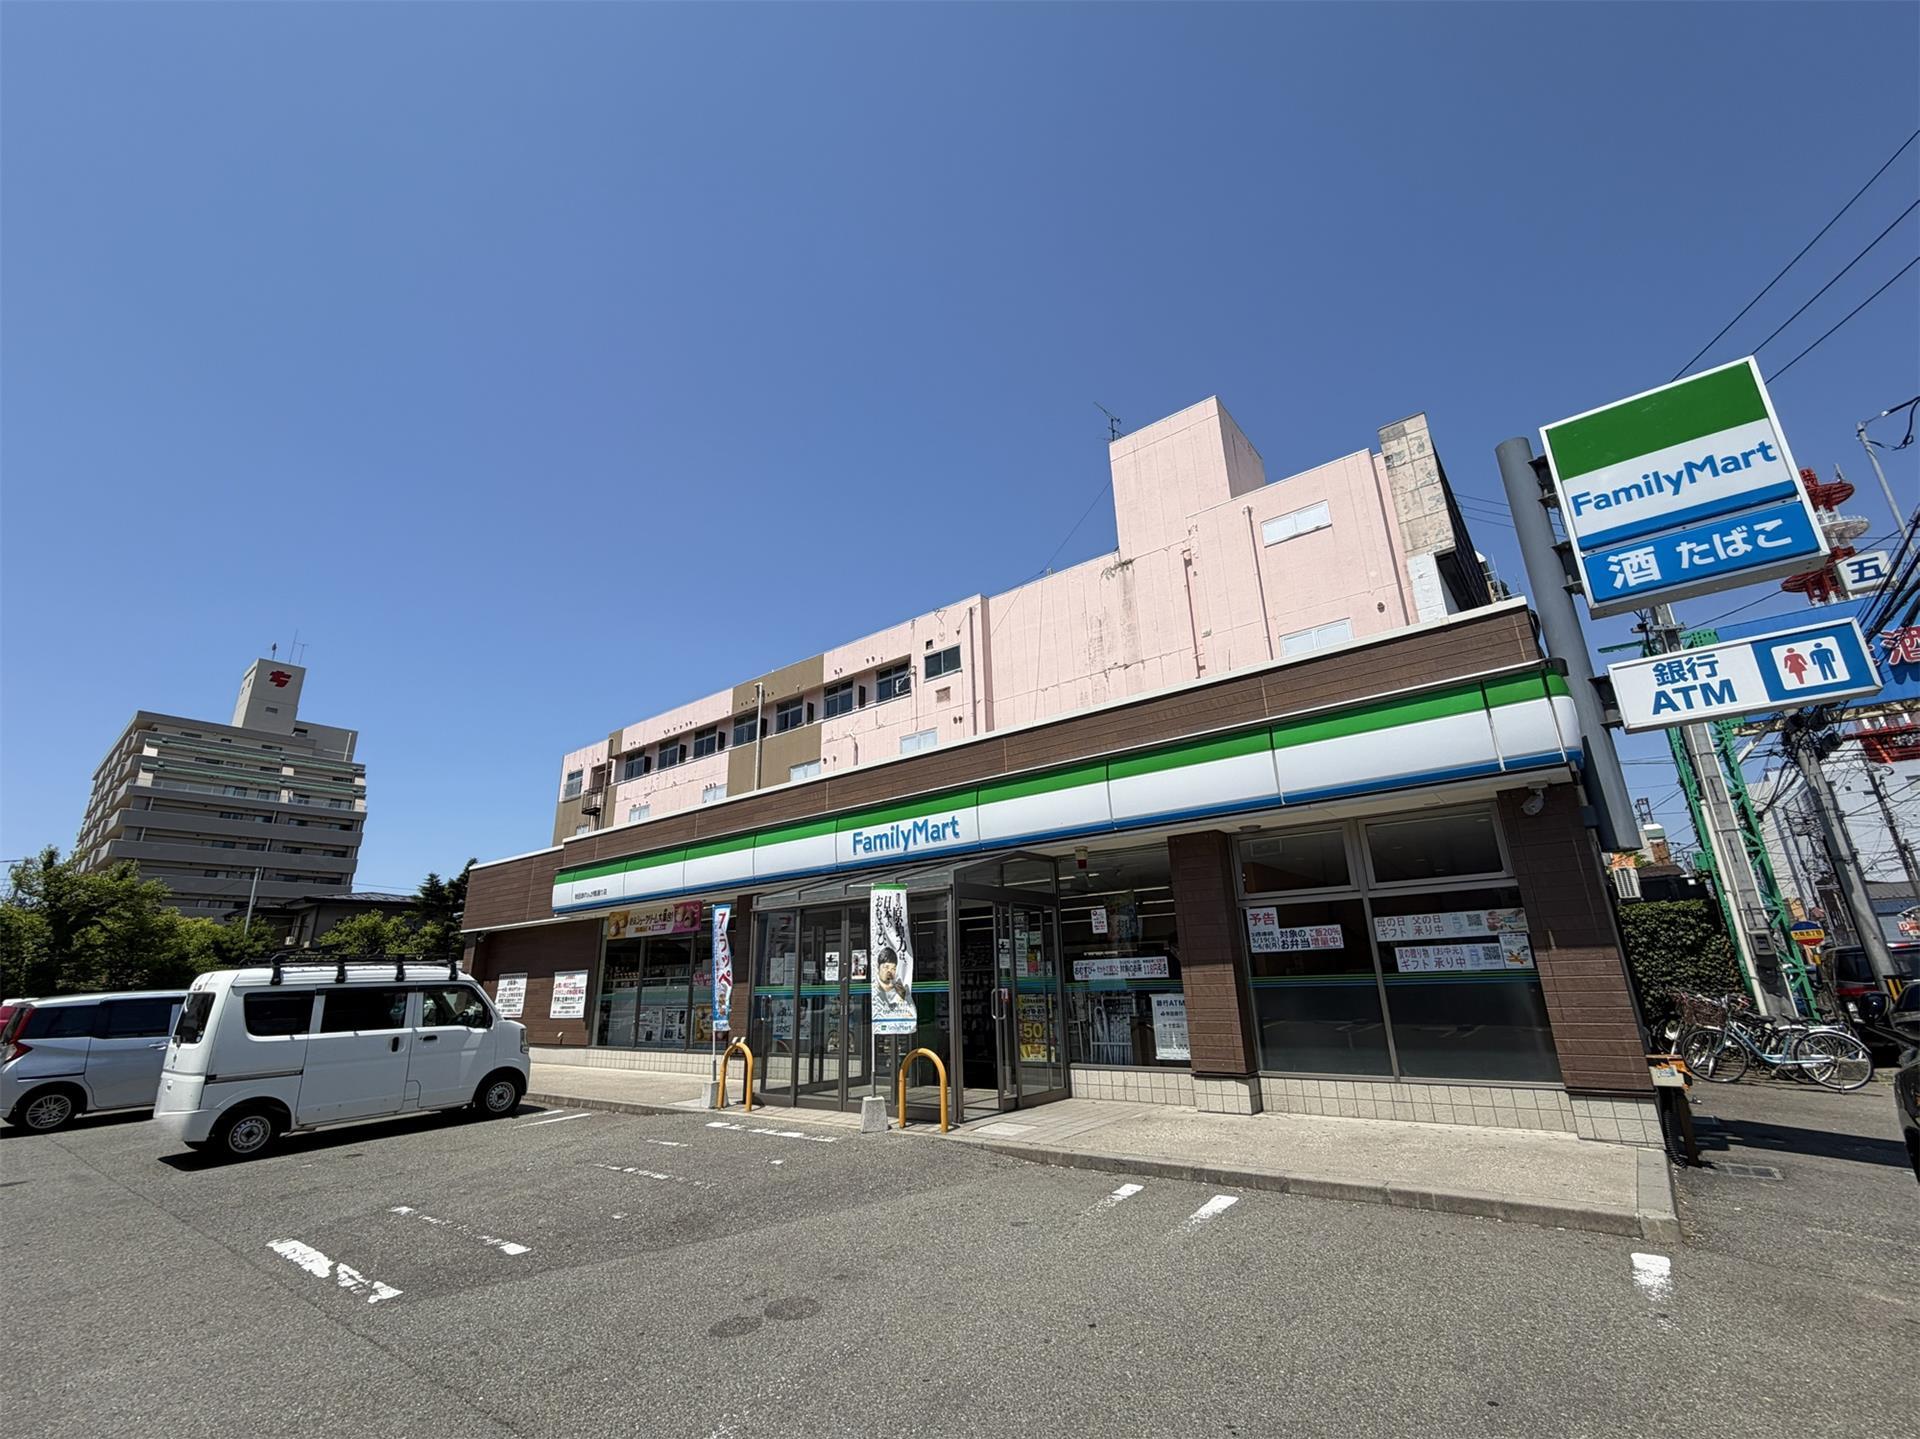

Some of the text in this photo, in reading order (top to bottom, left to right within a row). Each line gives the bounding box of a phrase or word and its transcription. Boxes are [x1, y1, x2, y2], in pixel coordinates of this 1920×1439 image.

[1570, 441, 1777, 518] FamilyMart
[1607, 519, 1793, 590] 酒 たばこ
[1846, 556, 1887, 584] 五
[1652, 653, 1719, 687] 銀行
[1652, 678, 1737, 716] ATM
[852, 815, 960, 855] FamilyMart
[1249, 912, 1275, 926] 予告
[1377, 917, 1405, 927] 母の日
[1412, 914, 1441, 924] 父の日
[1280, 929, 1306, 939] 対象の
[1380, 925, 1444, 938] ギフト 承り中
[1281, 938, 1311, 949] お弁当
[1401, 959, 1430, 971] ギフト
[1434, 958, 1466, 969] 承り中
